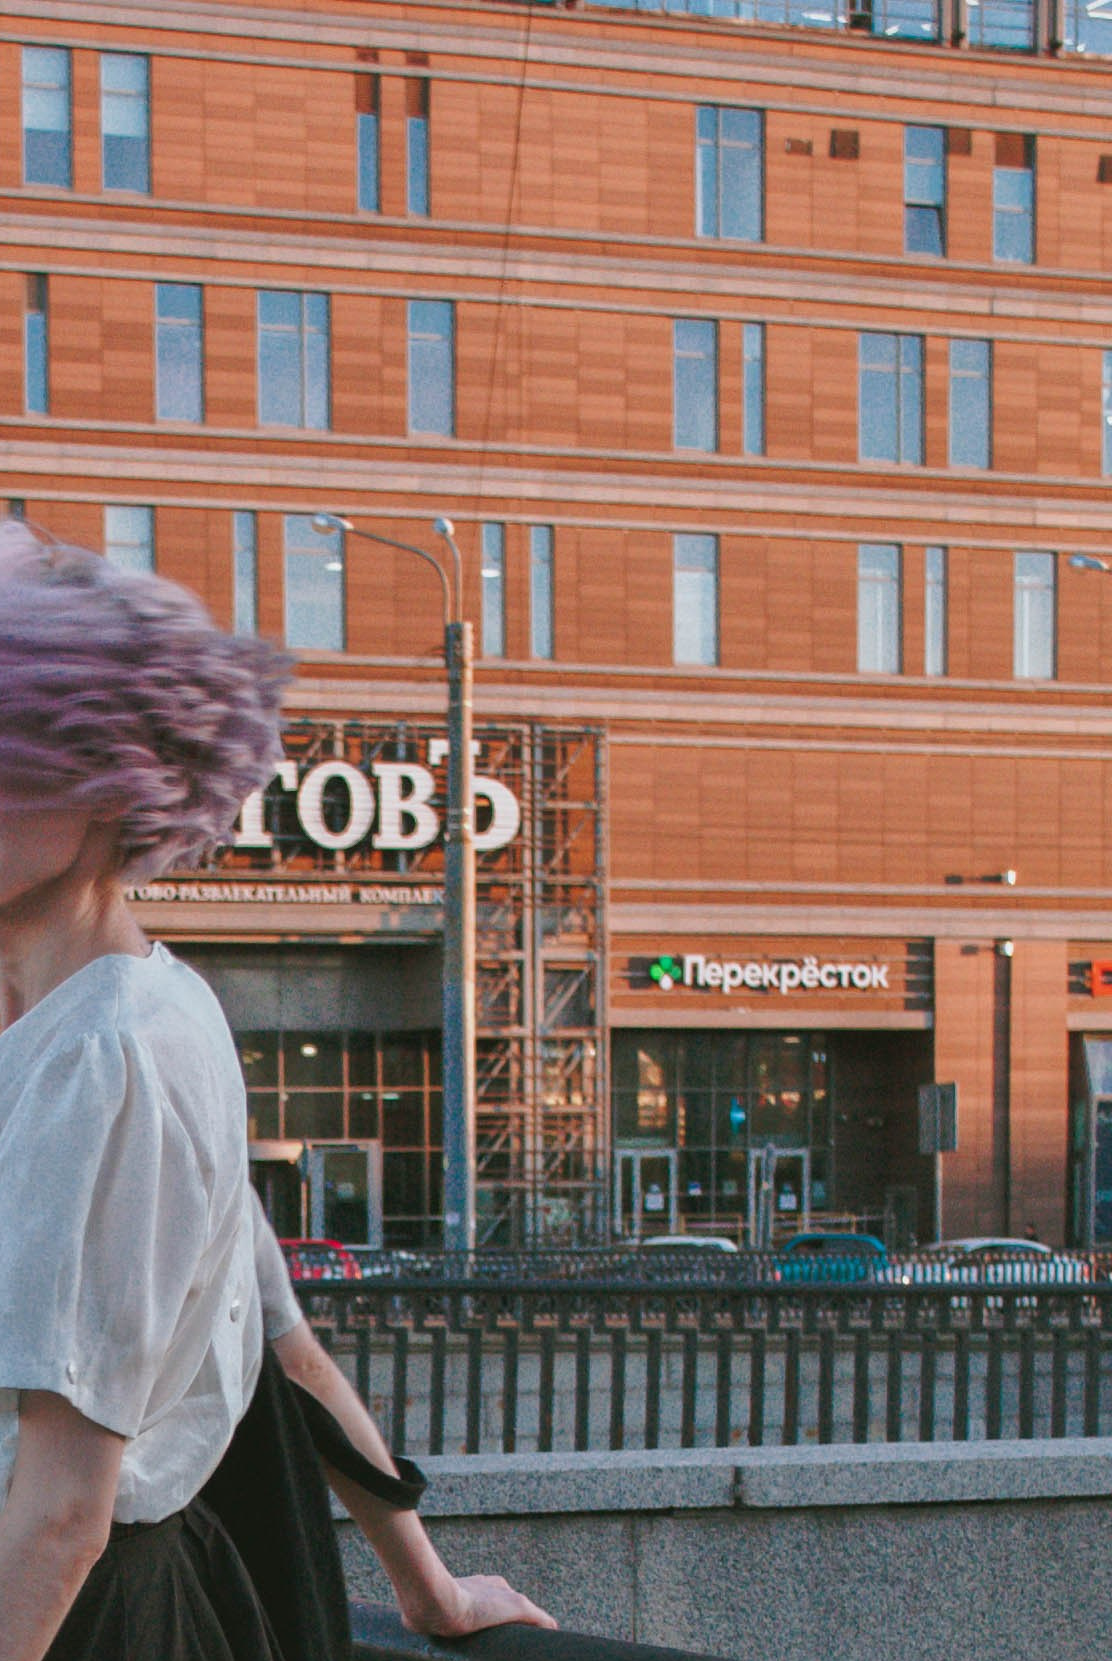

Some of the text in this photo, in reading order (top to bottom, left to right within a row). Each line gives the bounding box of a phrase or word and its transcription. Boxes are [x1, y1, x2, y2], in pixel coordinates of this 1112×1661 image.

[233, 738, 521, 852] ГОВЪ
[124, 883, 446, 905] ГОВО-РАЗВЛЕКАТЕЛЬНЫЙ КОМПЛЕК
[683, 954, 889, 995] Перекрёсток
